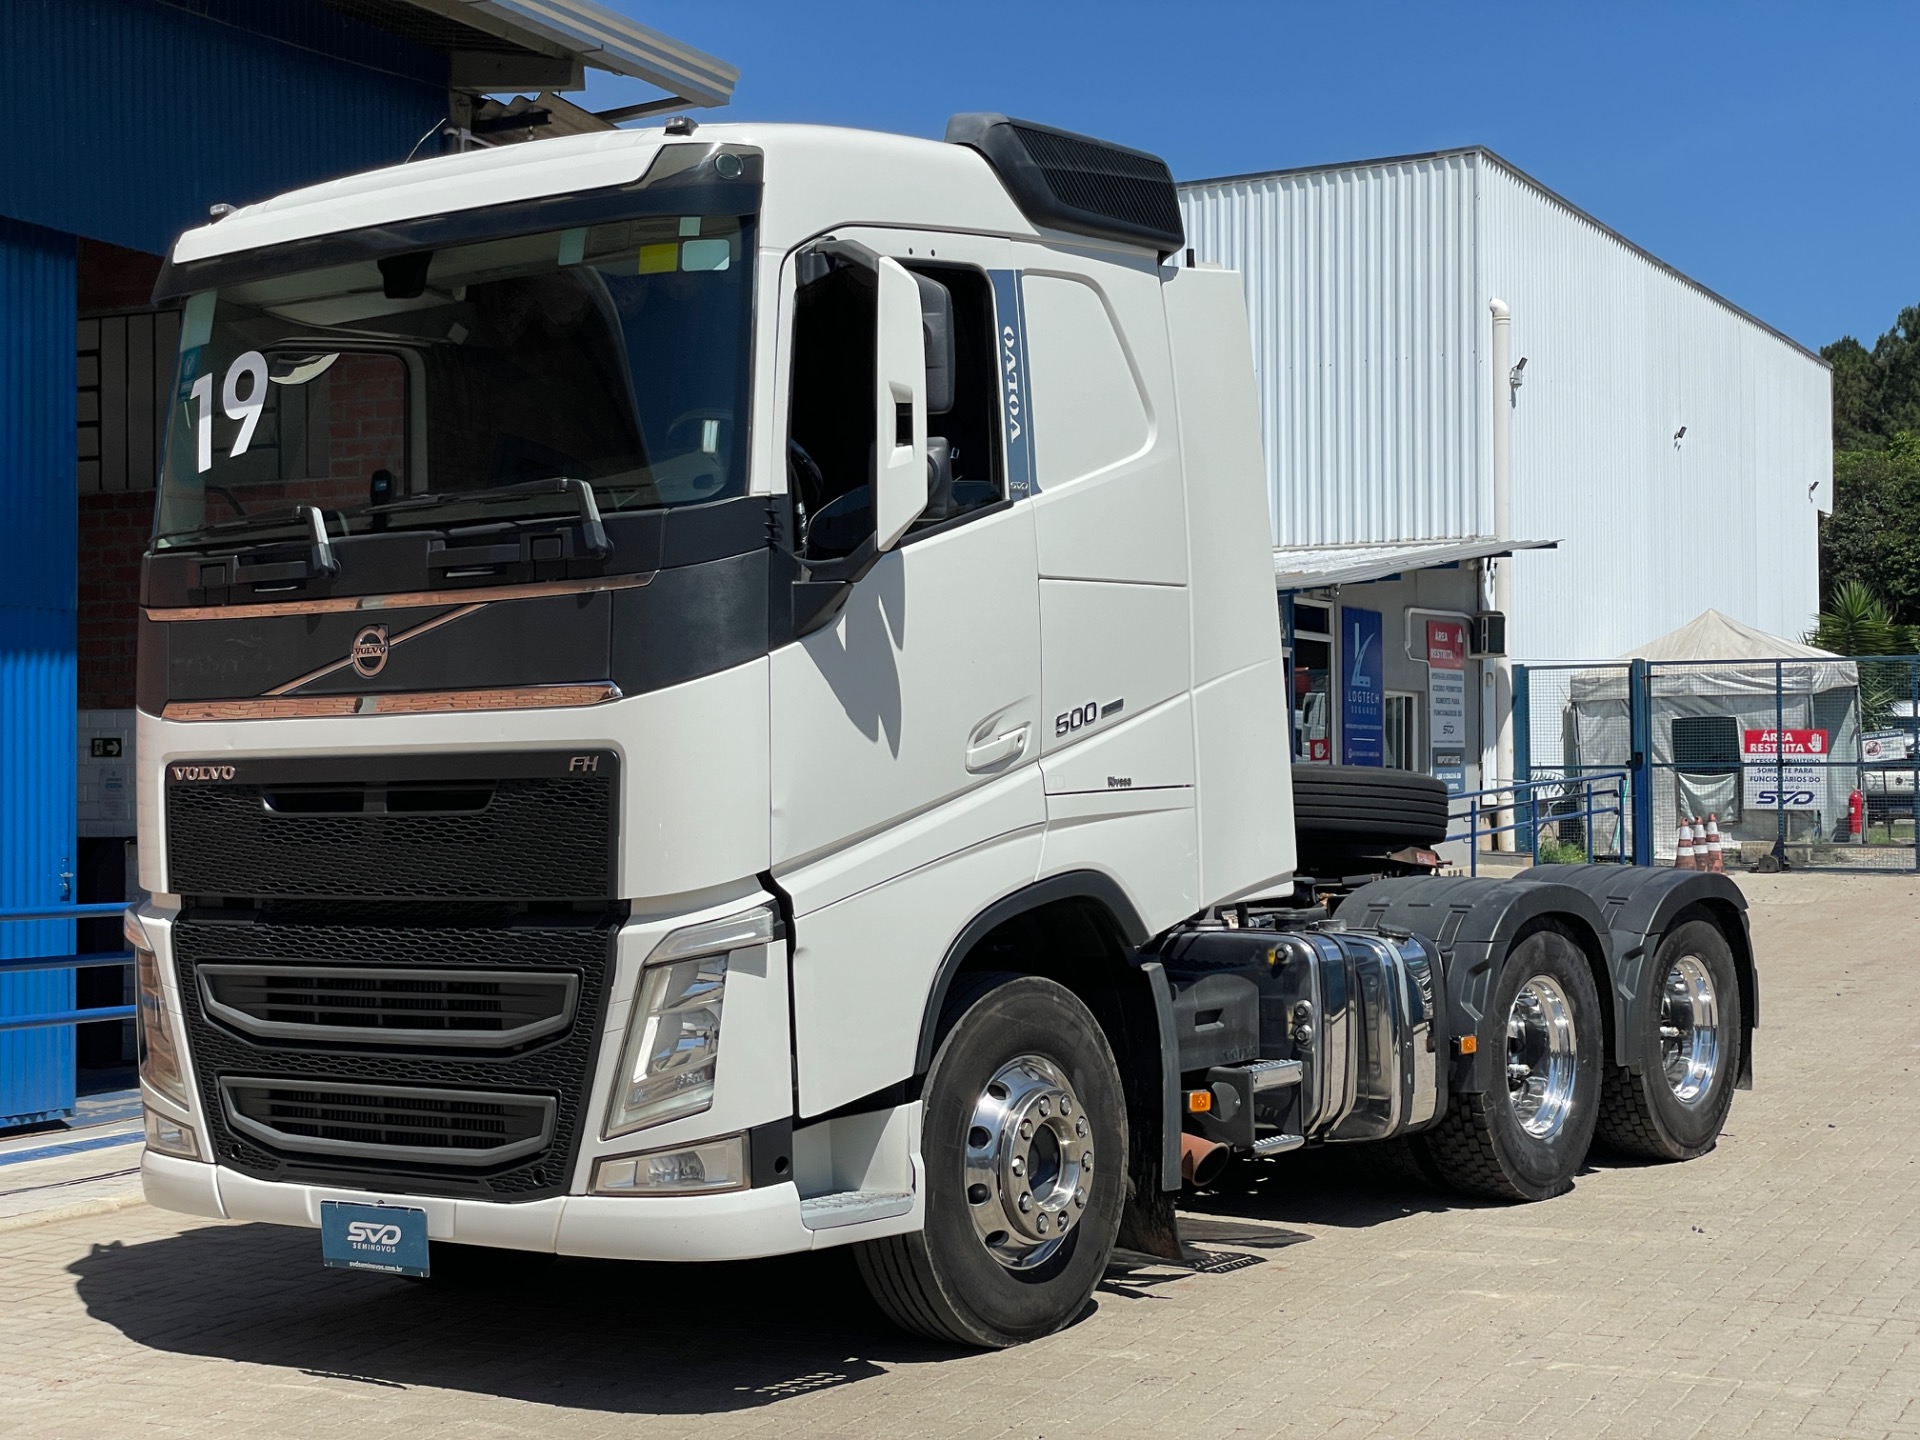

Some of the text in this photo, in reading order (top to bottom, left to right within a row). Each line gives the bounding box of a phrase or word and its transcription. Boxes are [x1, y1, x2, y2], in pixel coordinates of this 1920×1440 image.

[1003, 325, 1021, 443] VOLVO
[190, 350, 269, 474] 19
[355, 646, 386, 655] VOLVO
[1348, 690, 1380, 704] LOGTECH
[1055, 701, 1097, 738] 500
[569, 755, 599, 771] FH
[171, 765, 235, 780] VOLVO
[1750, 775, 1807, 783] FUNCIOÁRIOS
[1756, 791, 1815, 805] SVD
[347, 1221, 402, 1245] SVD
[352, 1242, 396, 1253] SEMINOVOS
[349, 1261, 403, 1272] svdseminovos.com.br
